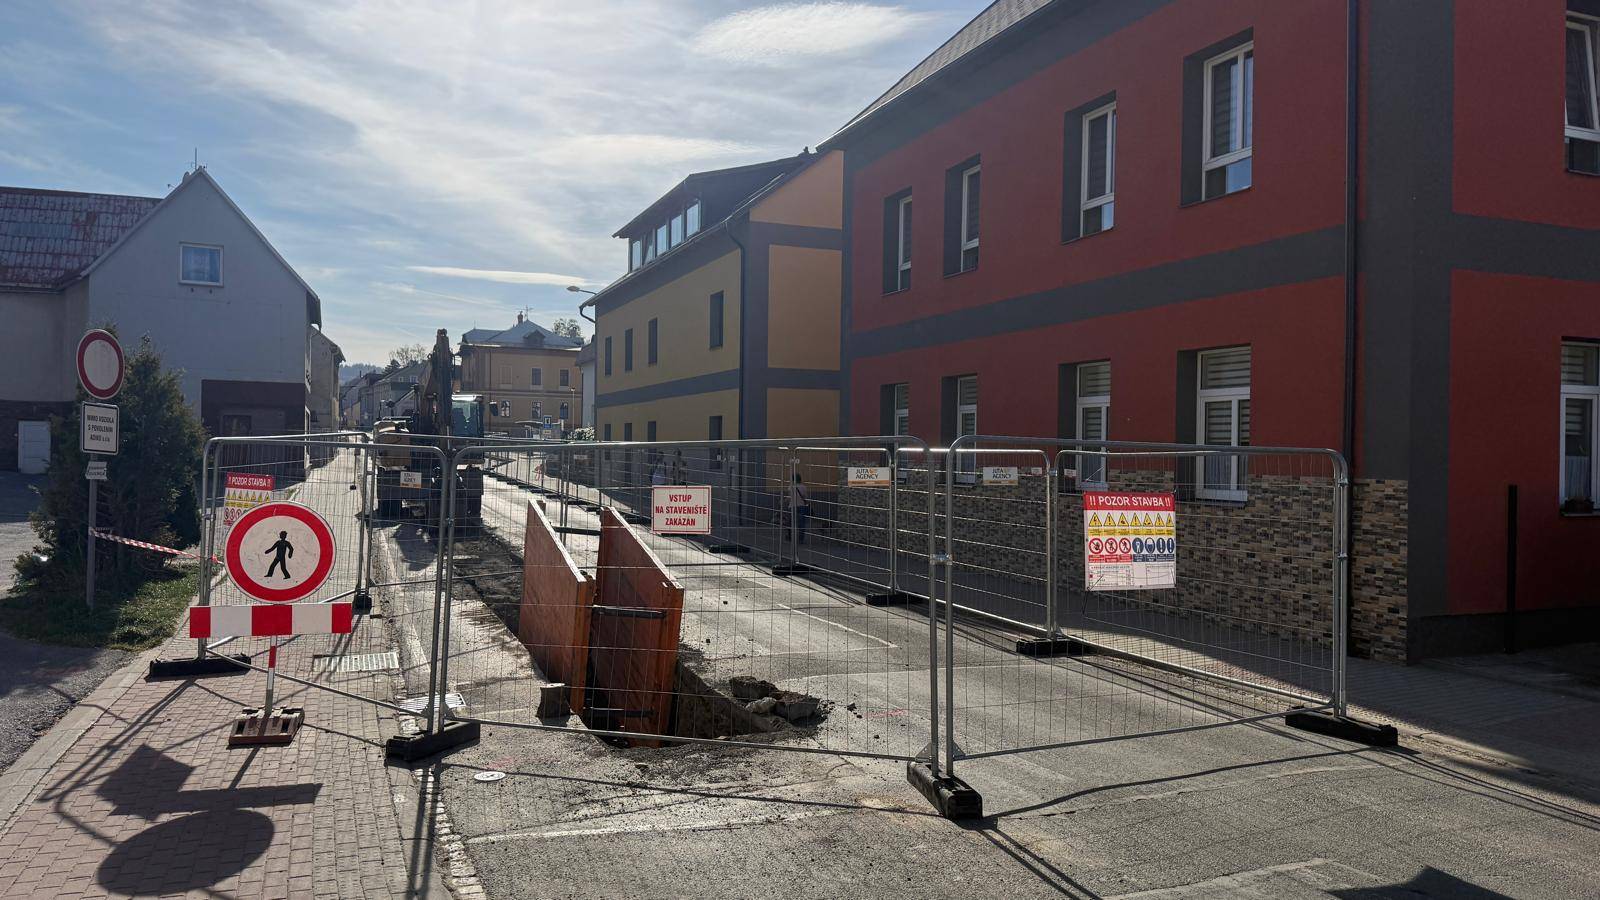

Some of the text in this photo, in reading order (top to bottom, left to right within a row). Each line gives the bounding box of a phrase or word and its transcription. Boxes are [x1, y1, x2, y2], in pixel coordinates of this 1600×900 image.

[231, 476, 248, 486] POZOR
[248, 477, 267, 488] STAVBA
[669, 494, 692, 502] VSTUP
[1098, 495, 1131, 506] POZOR
[1131, 496, 1165, 507] STAVBA
[655, 504, 707, 515] NA STAVENIŠTĚ
